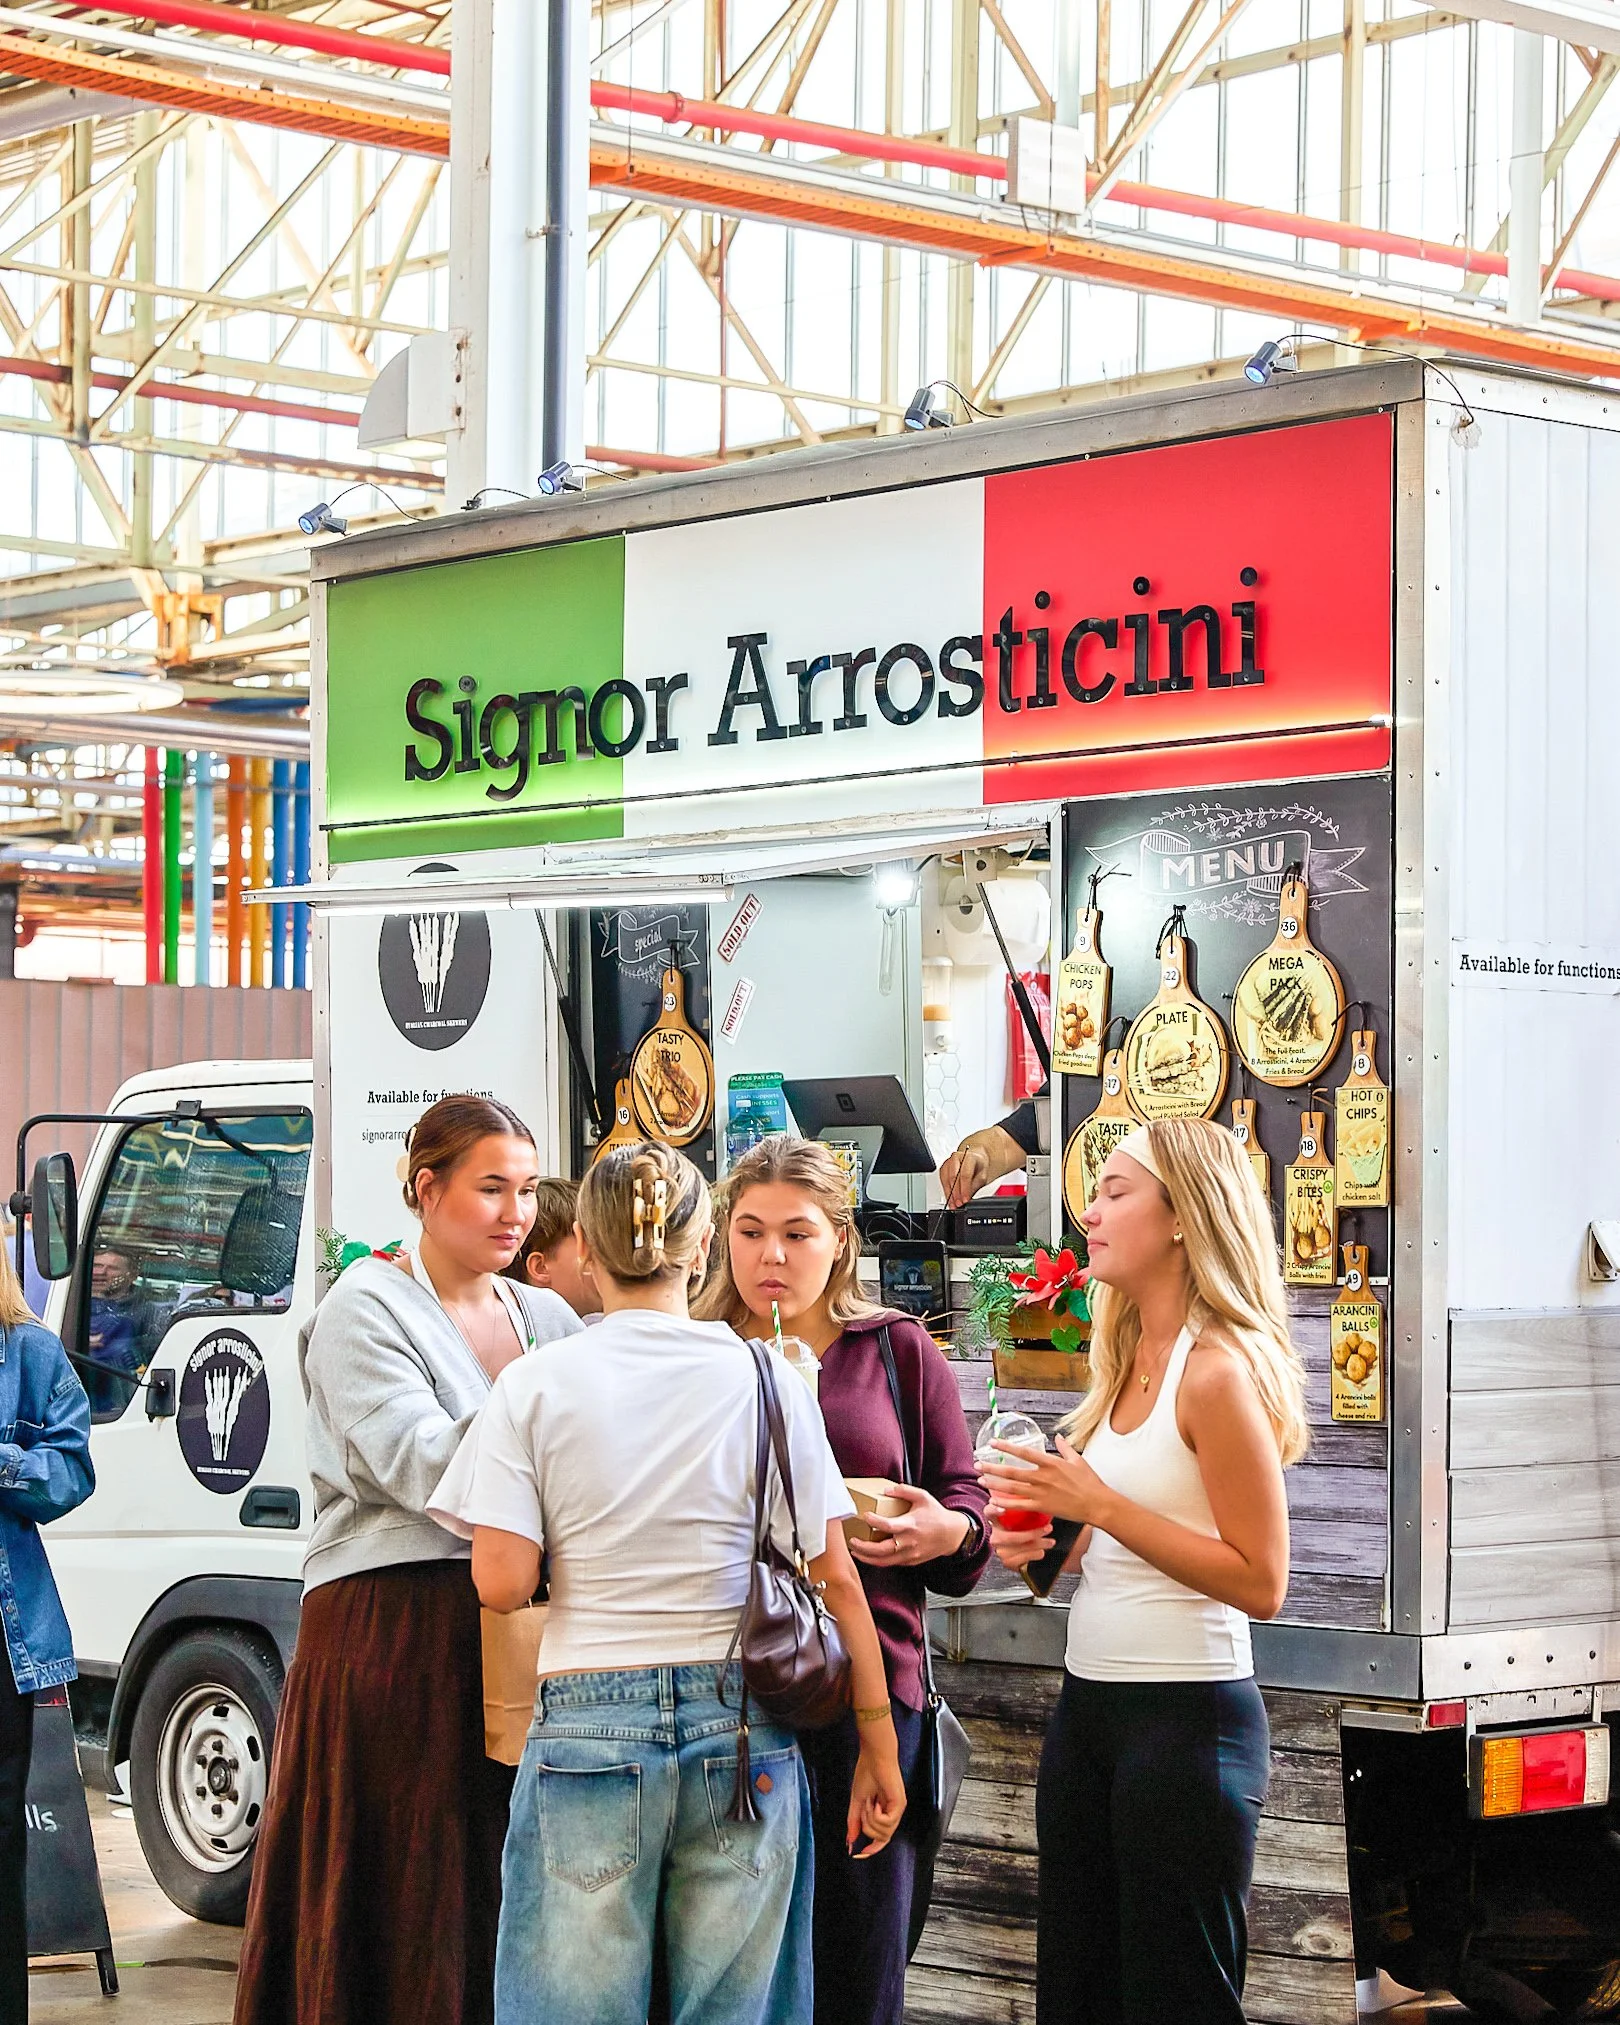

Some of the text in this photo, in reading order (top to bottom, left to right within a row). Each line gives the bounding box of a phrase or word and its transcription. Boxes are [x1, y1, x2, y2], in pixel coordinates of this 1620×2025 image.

[405, 567, 1265, 801] Signor Arrosticini
[1162, 841, 1285, 889] MENU
[723, 900, 759, 956] SOLD OUT
[1080, 936, 1086, 946] 9
[1064, 963, 1101, 975] CHICKEN
[1269, 957, 1304, 970] MEGA
[1460, 954, 1620, 980] Available for functions
[1070, 979, 1093, 990] POPS
[1270, 977, 1302, 990] PACK
[726, 985, 748, 1032] SOLD OUT
[1156, 1011, 1188, 1025] PLATE
[657, 1033, 684, 1045] TASTY
[661, 1050, 681, 1063] TRIO
[1281, 1067, 1286, 1075] &
[1287, 1067, 1305, 1075] Bread
[367, 1090, 420, 1104] Available
[422, 1089, 439, 1103] for
[1351, 1090, 1373, 1102] HOT
[1177, 1101, 1190, 1109] with
[1190, 1099, 1207, 1108] Bread
[619, 1109, 628, 1117] 16
[1184, 1109, 1199, 1119] Salad
[1346, 1107, 1377, 1120] CHIPS
[1098, 1123, 1129, 1136] TASTE
[1293, 1168, 1328, 1181] CRISPY
[1344, 1180, 1380, 1190] Chips with
[1297, 1186, 1324, 1198] BITES
[1342, 1191, 1381, 1201] chicken salt
[1291, 1262, 1308, 1271] Crispy
[1332, 1306, 1378, 1316] ARANCINI
[1341, 1321, 1370, 1332] BALLS
[189, 1340, 217, 1373] signor
[1355, 1412, 1365, 1420] and
